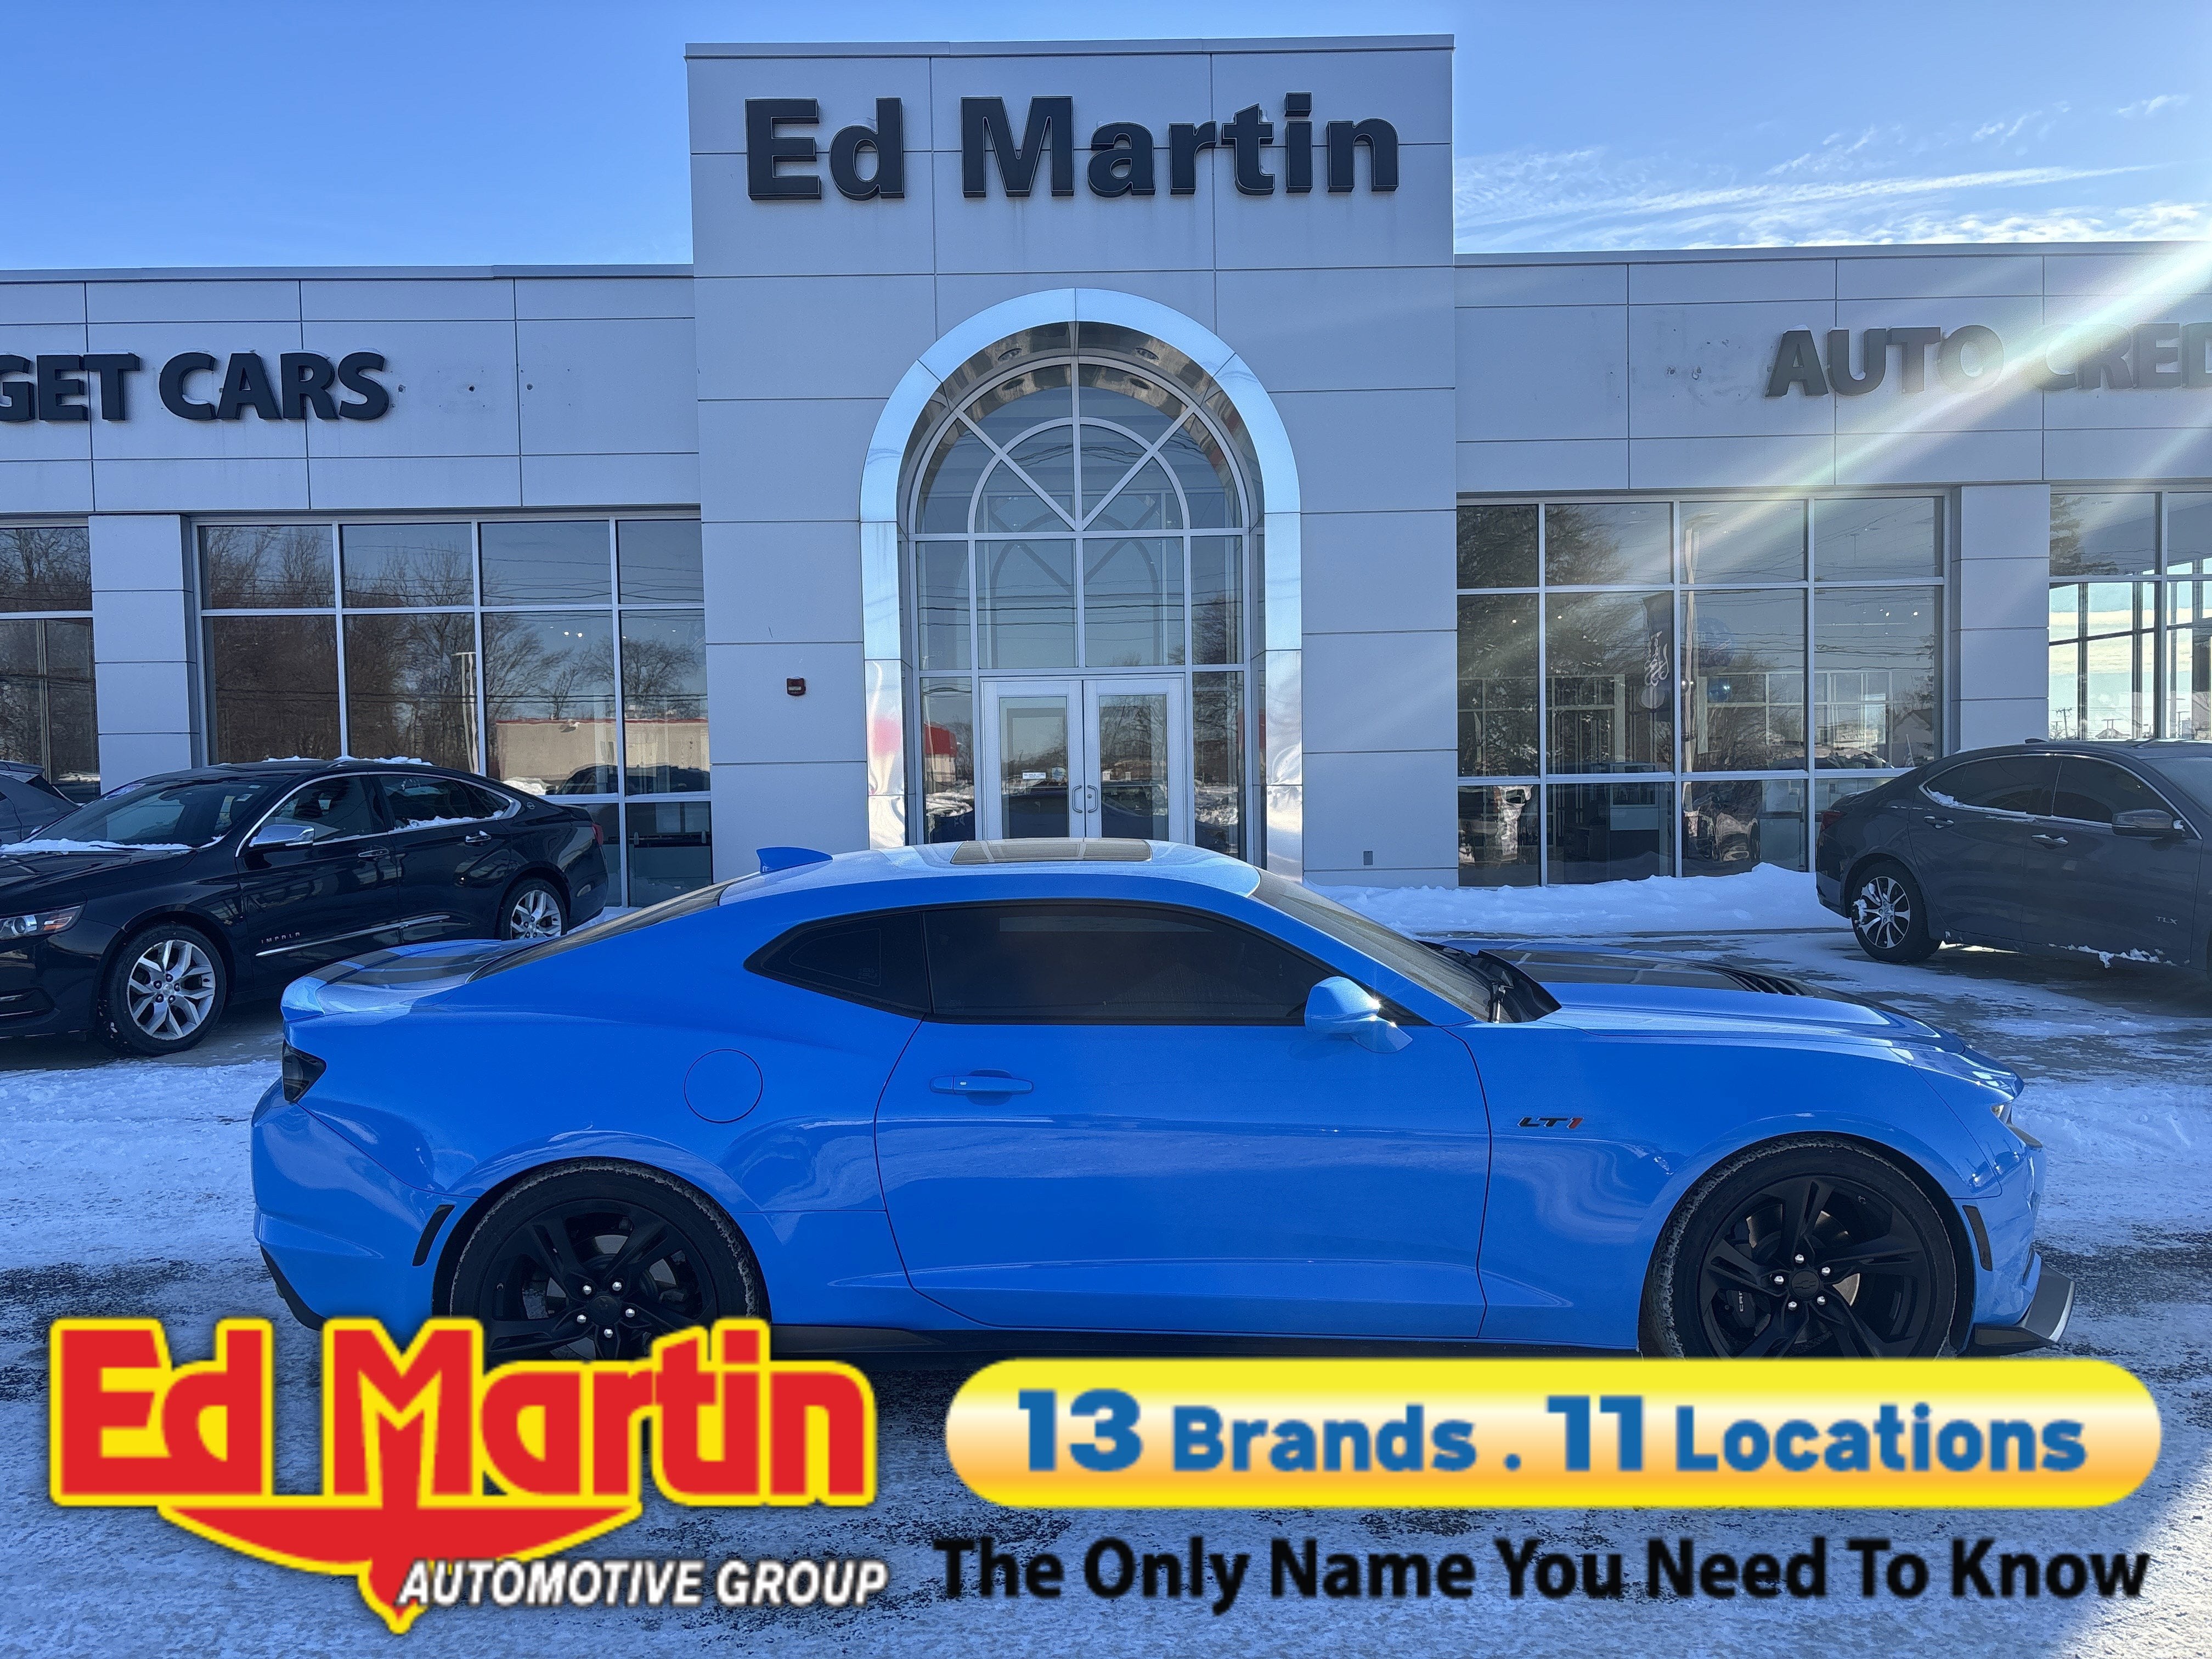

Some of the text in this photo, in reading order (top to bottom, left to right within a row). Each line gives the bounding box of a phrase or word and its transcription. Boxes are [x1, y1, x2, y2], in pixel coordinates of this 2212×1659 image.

[745, 92, 1400, 201] Ed Martin
[1765, 324, 2004, 397] AUTO
[159, 352, 389, 421] CARS
[261, 932, 300, 944] IMPALA
[2155, 916, 2178, 925] TLX
[1517, 1116, 1584, 1128] LT1
